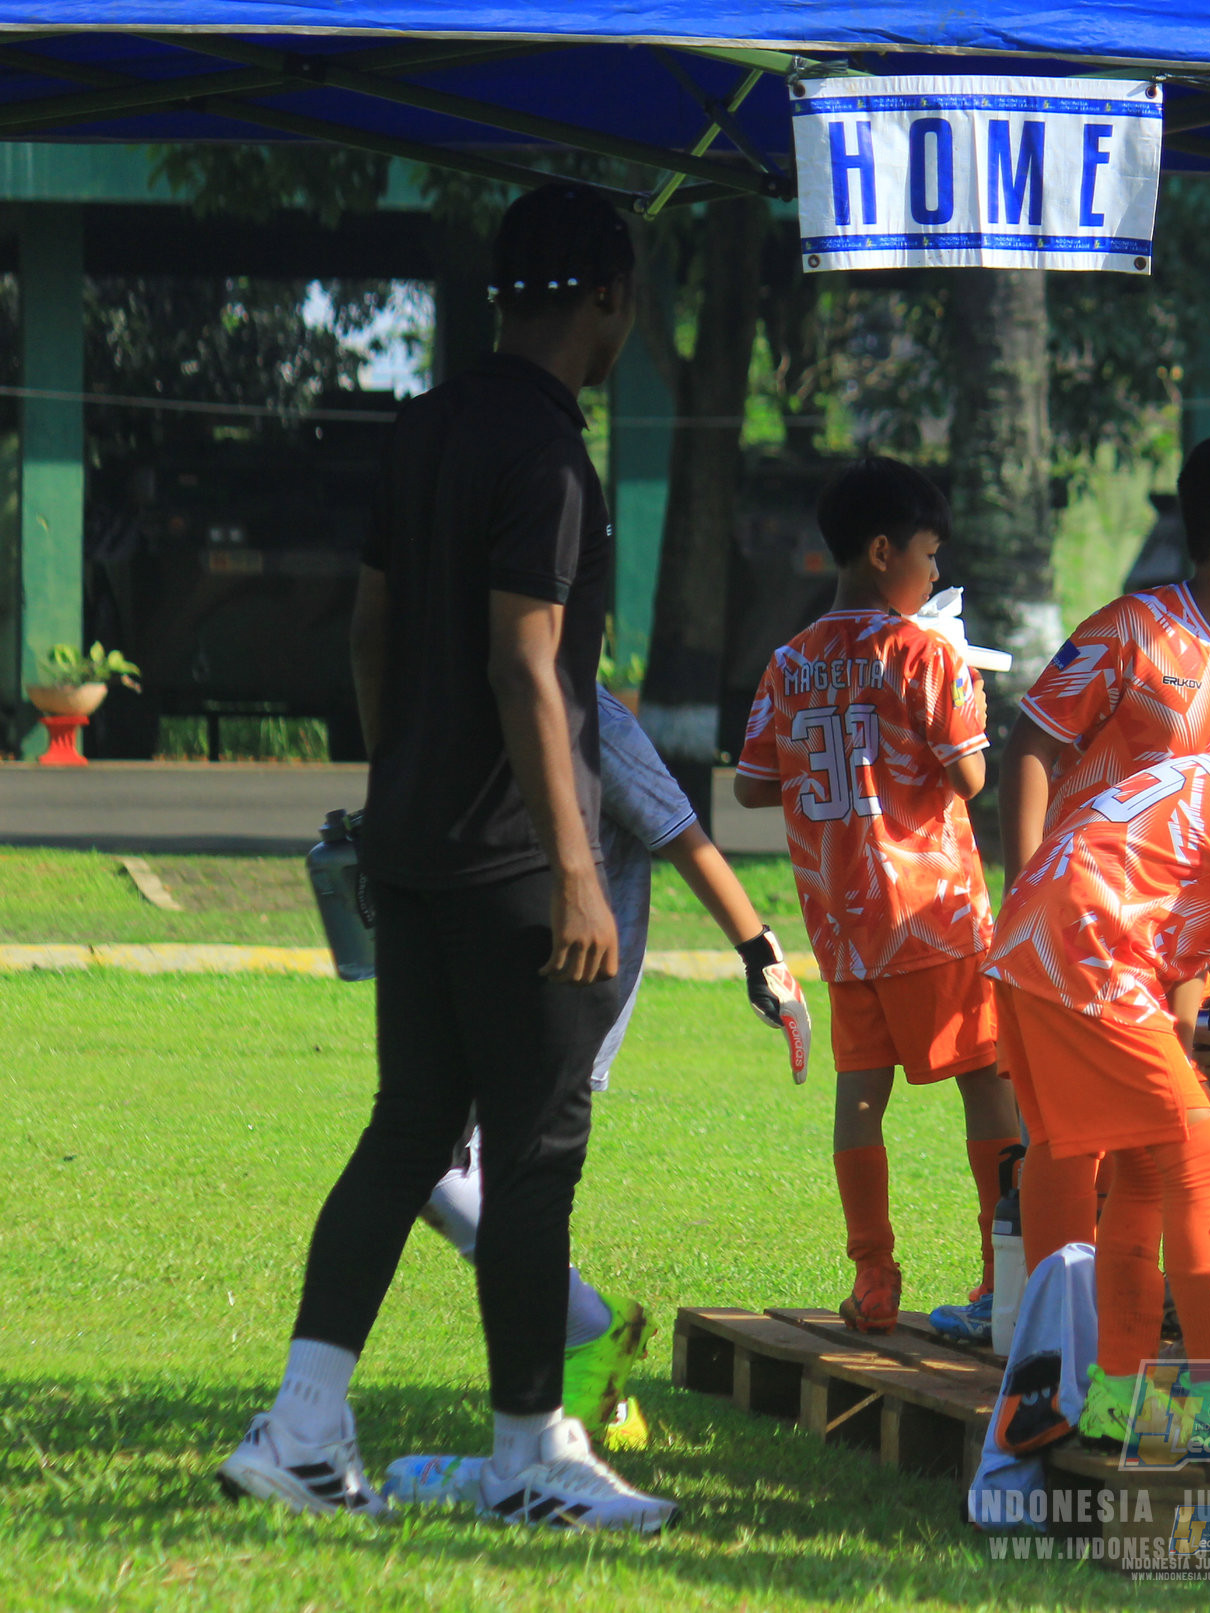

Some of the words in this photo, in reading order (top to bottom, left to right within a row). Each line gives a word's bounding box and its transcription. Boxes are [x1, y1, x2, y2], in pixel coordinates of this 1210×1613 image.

[828, 117, 1114, 227] HOME
[1162, 675, 1203, 690] ERUKOV
[791, 703, 883, 822] 32
[788, 1020, 805, 1067] adidas
